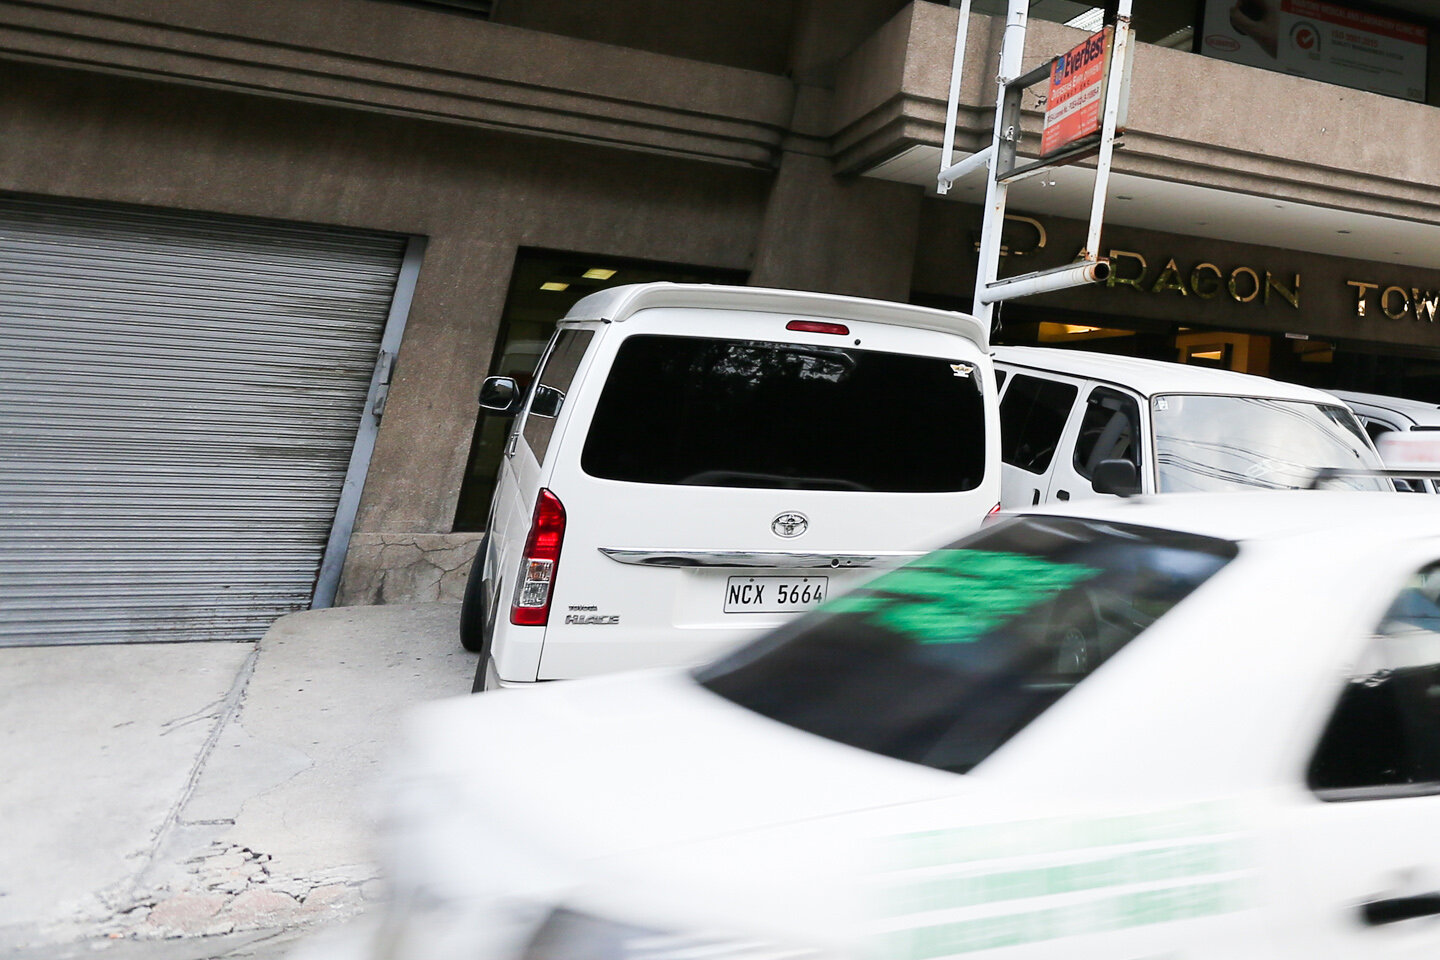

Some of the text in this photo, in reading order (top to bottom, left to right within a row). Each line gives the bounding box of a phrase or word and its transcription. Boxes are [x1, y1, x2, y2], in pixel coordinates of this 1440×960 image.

[1065, 32, 1105, 78] EverBest
[728, 585, 822, 604] NCX 5664
[565, 615, 620, 625] HIACE
